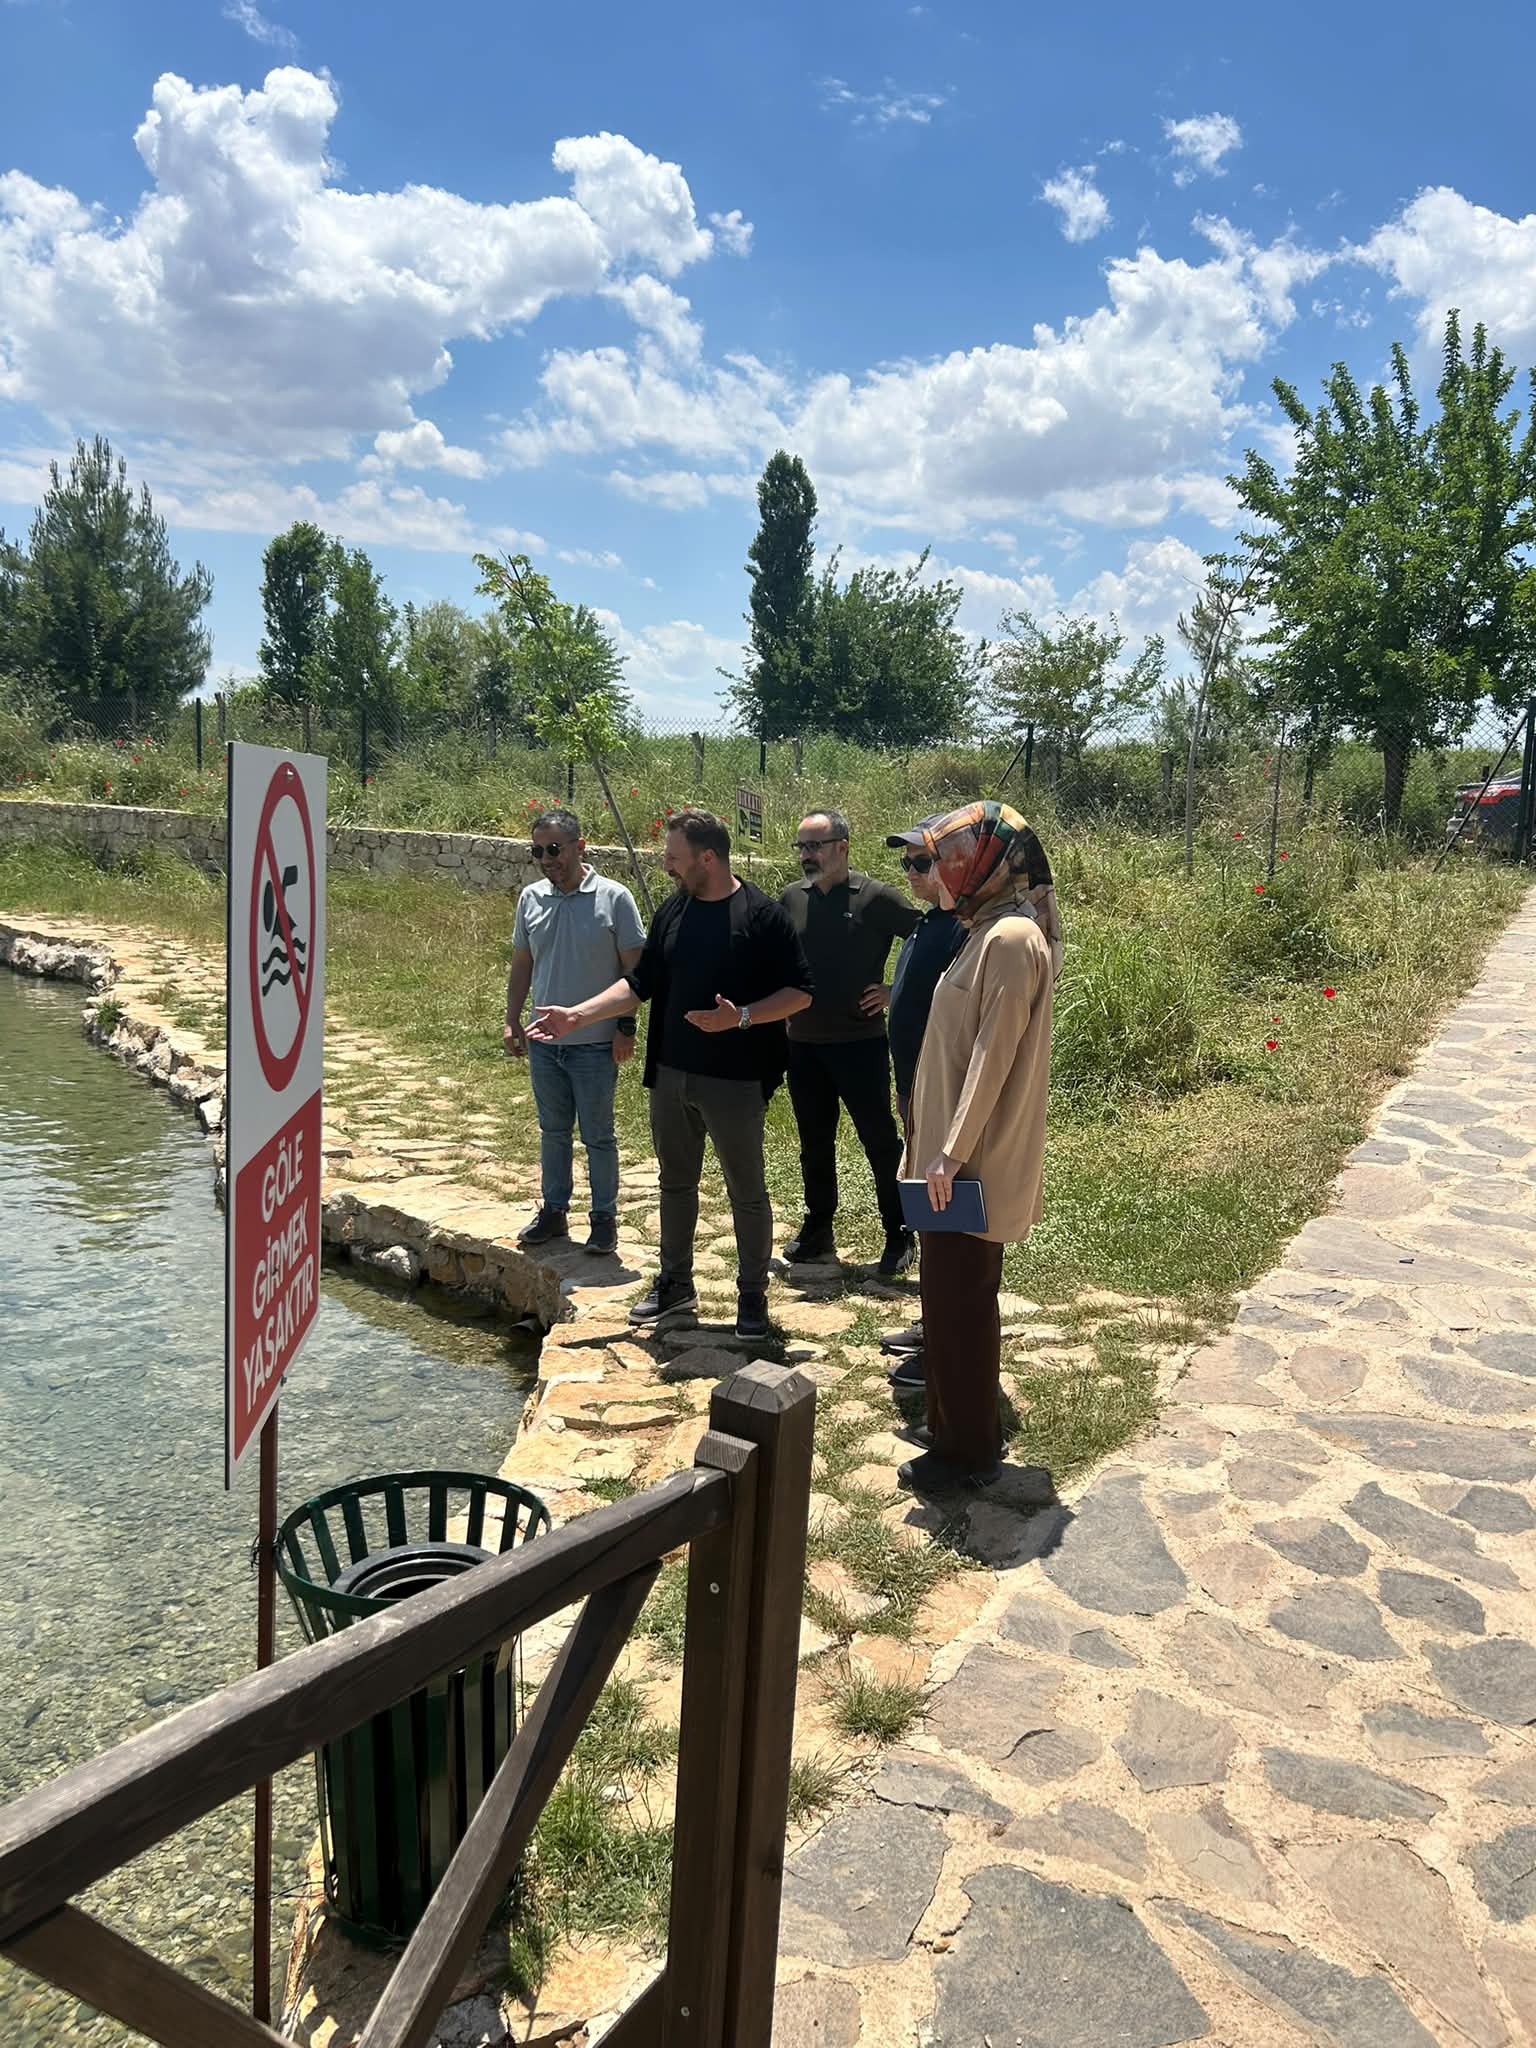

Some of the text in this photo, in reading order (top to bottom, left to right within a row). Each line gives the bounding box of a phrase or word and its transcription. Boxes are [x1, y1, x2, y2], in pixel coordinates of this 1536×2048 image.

[262, 1130, 303, 1223] GÖLE
[253, 1197, 308, 1319] GİRMEK
[243, 1254, 314, 1416] YASAKTIR
